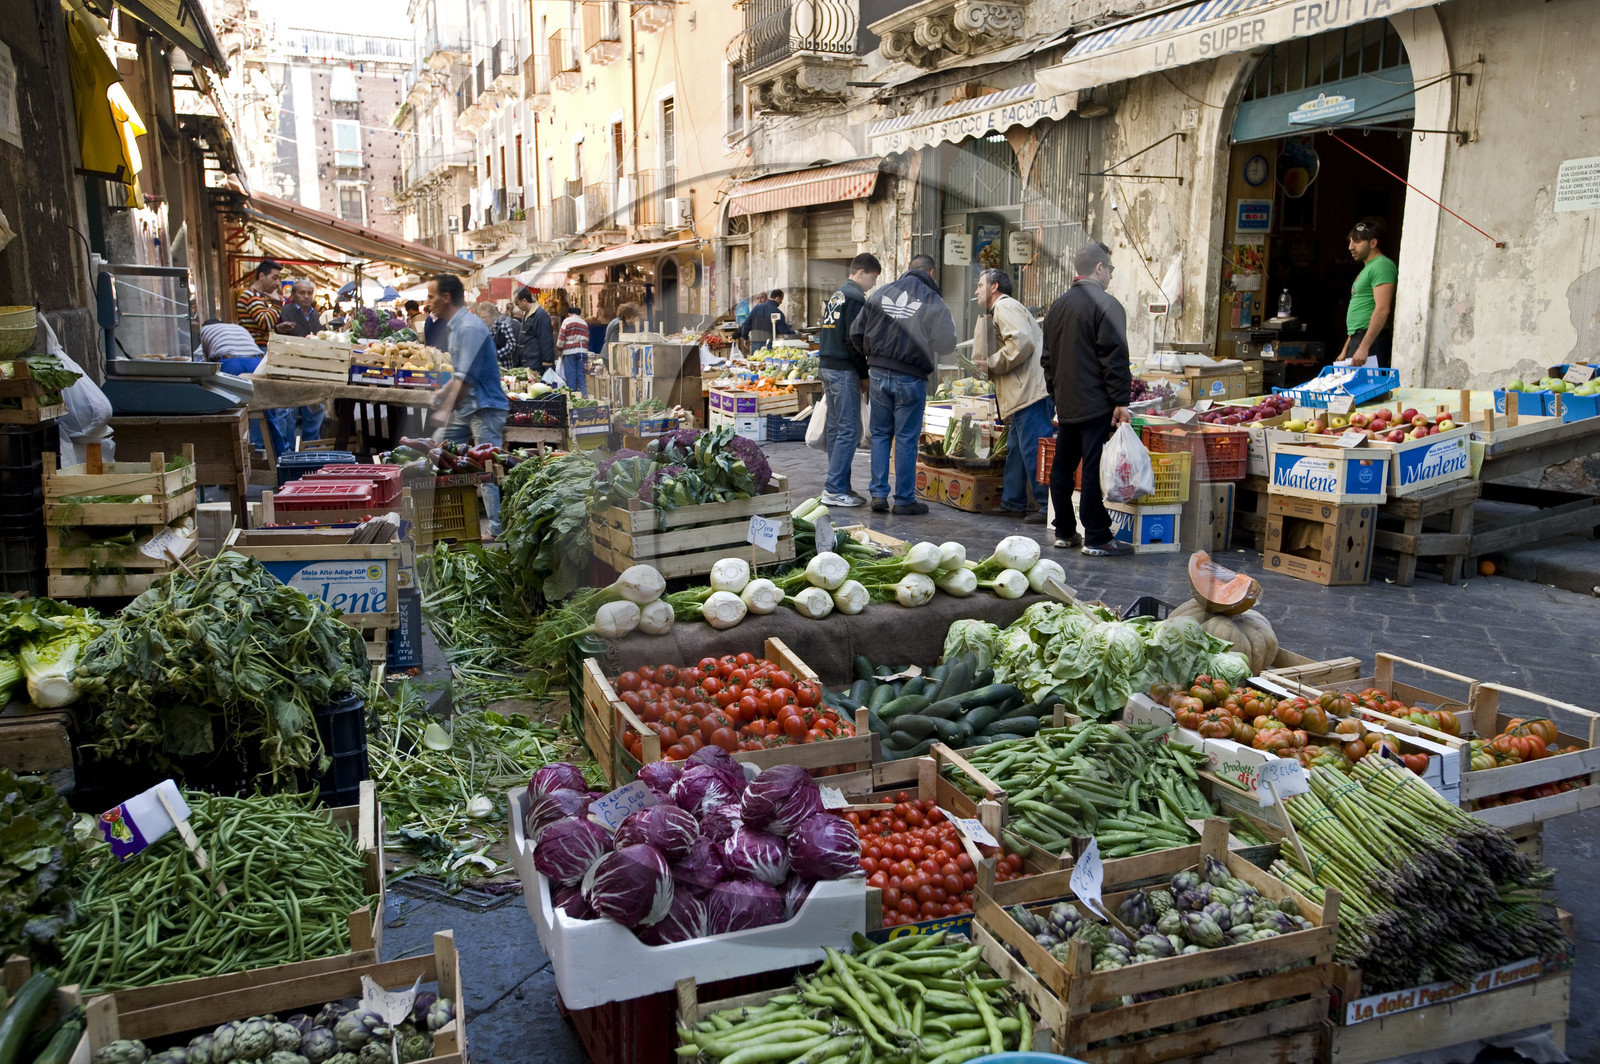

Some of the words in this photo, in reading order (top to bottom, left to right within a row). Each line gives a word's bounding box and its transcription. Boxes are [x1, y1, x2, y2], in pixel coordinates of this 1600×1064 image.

[1154, 42, 1176, 66] LA
[1199, 18, 1266, 55] SUPER
[1292, 0, 1391, 33] FRUTTA
[987, 112, 995, 128] E
[1406, 454, 1466, 484] Marlene
[409, 479, 435, 489] Frutti
[438, 477, 445, 487] di
[448, 475, 476, 486] Sicilia
[1276, 467, 1337, 493] Marlene
[1222, 760, 1255, 776] Prodotti
[1280, 762, 1299, 776] EURO
[1237, 772, 1249, 786] di
[1355, 1003, 1373, 1020] Le
[1377, 991, 1415, 1014] dolci
[1475, 973, 1491, 990] di
